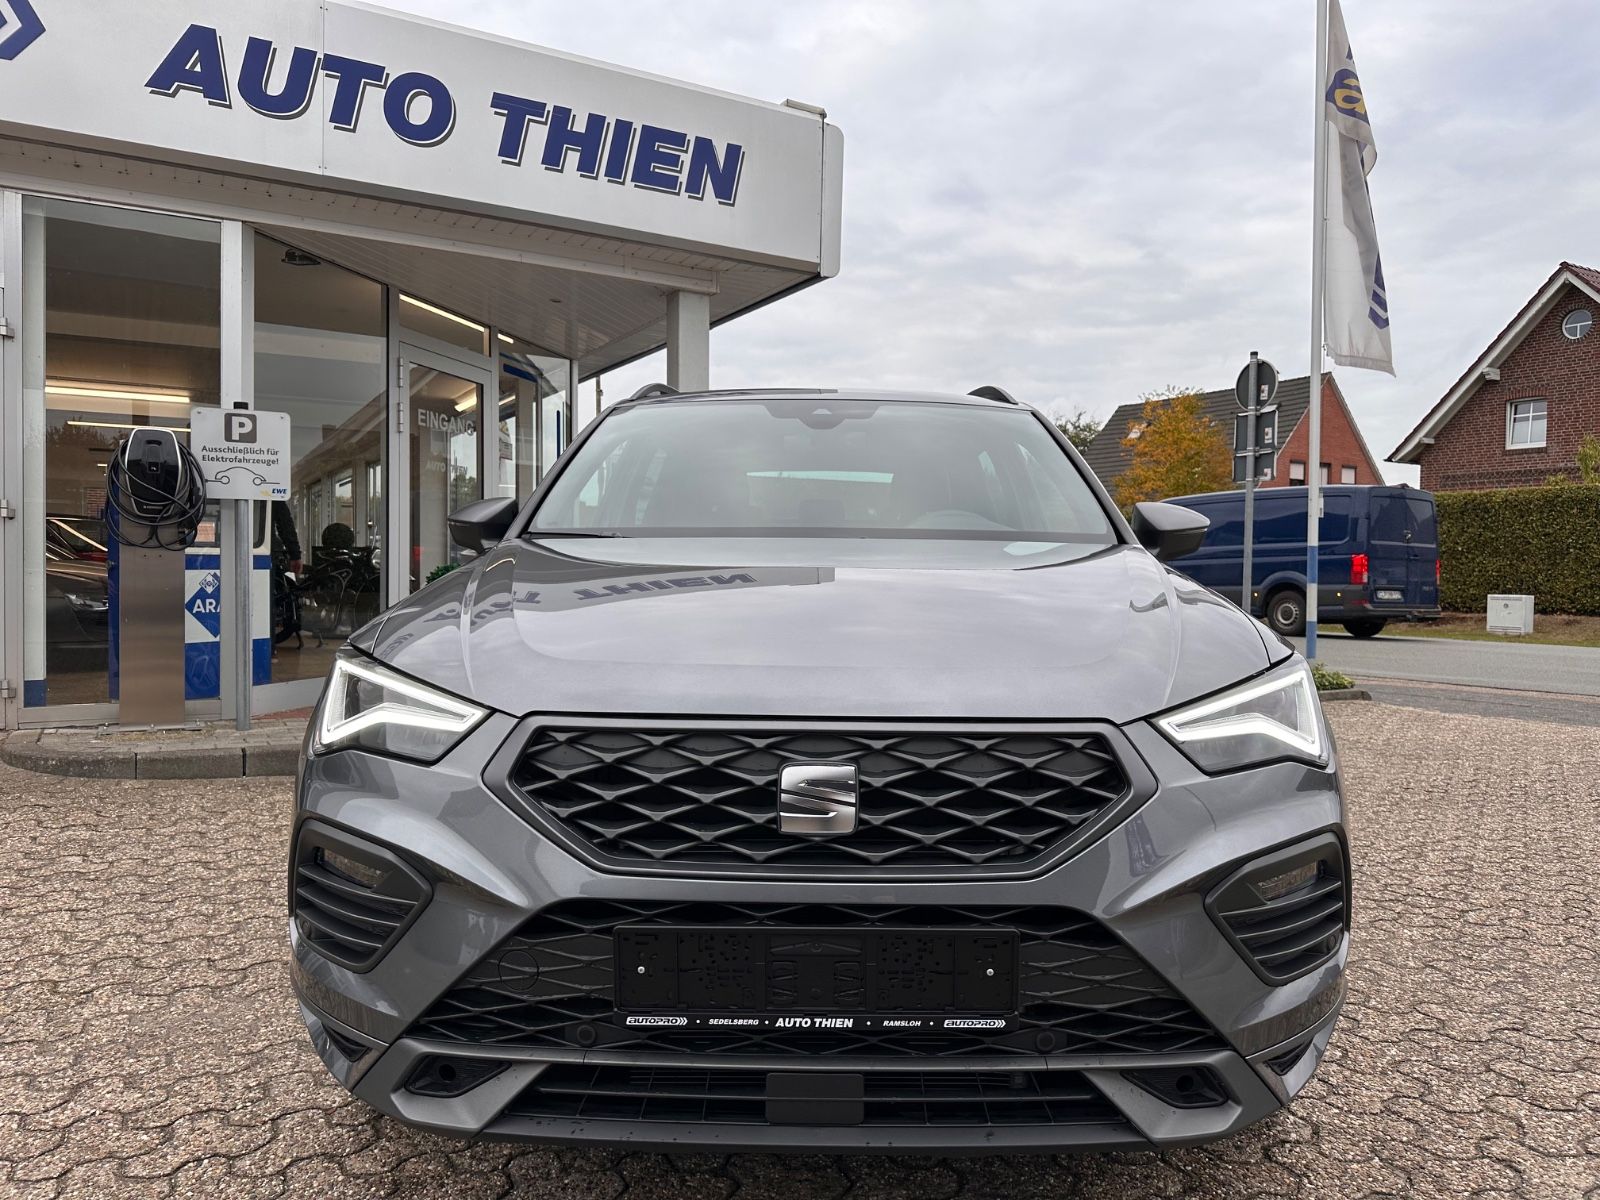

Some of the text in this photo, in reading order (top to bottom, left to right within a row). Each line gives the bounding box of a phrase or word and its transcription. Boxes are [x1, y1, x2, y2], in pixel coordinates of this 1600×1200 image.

[145, 24, 744, 206] AUTO THIEN
[231, 415, 253, 441] P
[417, 408, 474, 437] EINGANG
[201, 445, 280, 456] Ausschließlich für
[202, 455, 279, 466] Elektrofahrzeuge!
[708, 1018, 759, 1026] SEDELSBERG
[775, 1017, 811, 1028] AUTO
[813, 1017, 854, 1028] THIEN
[883, 1019, 922, 1028] RAMSLOH
